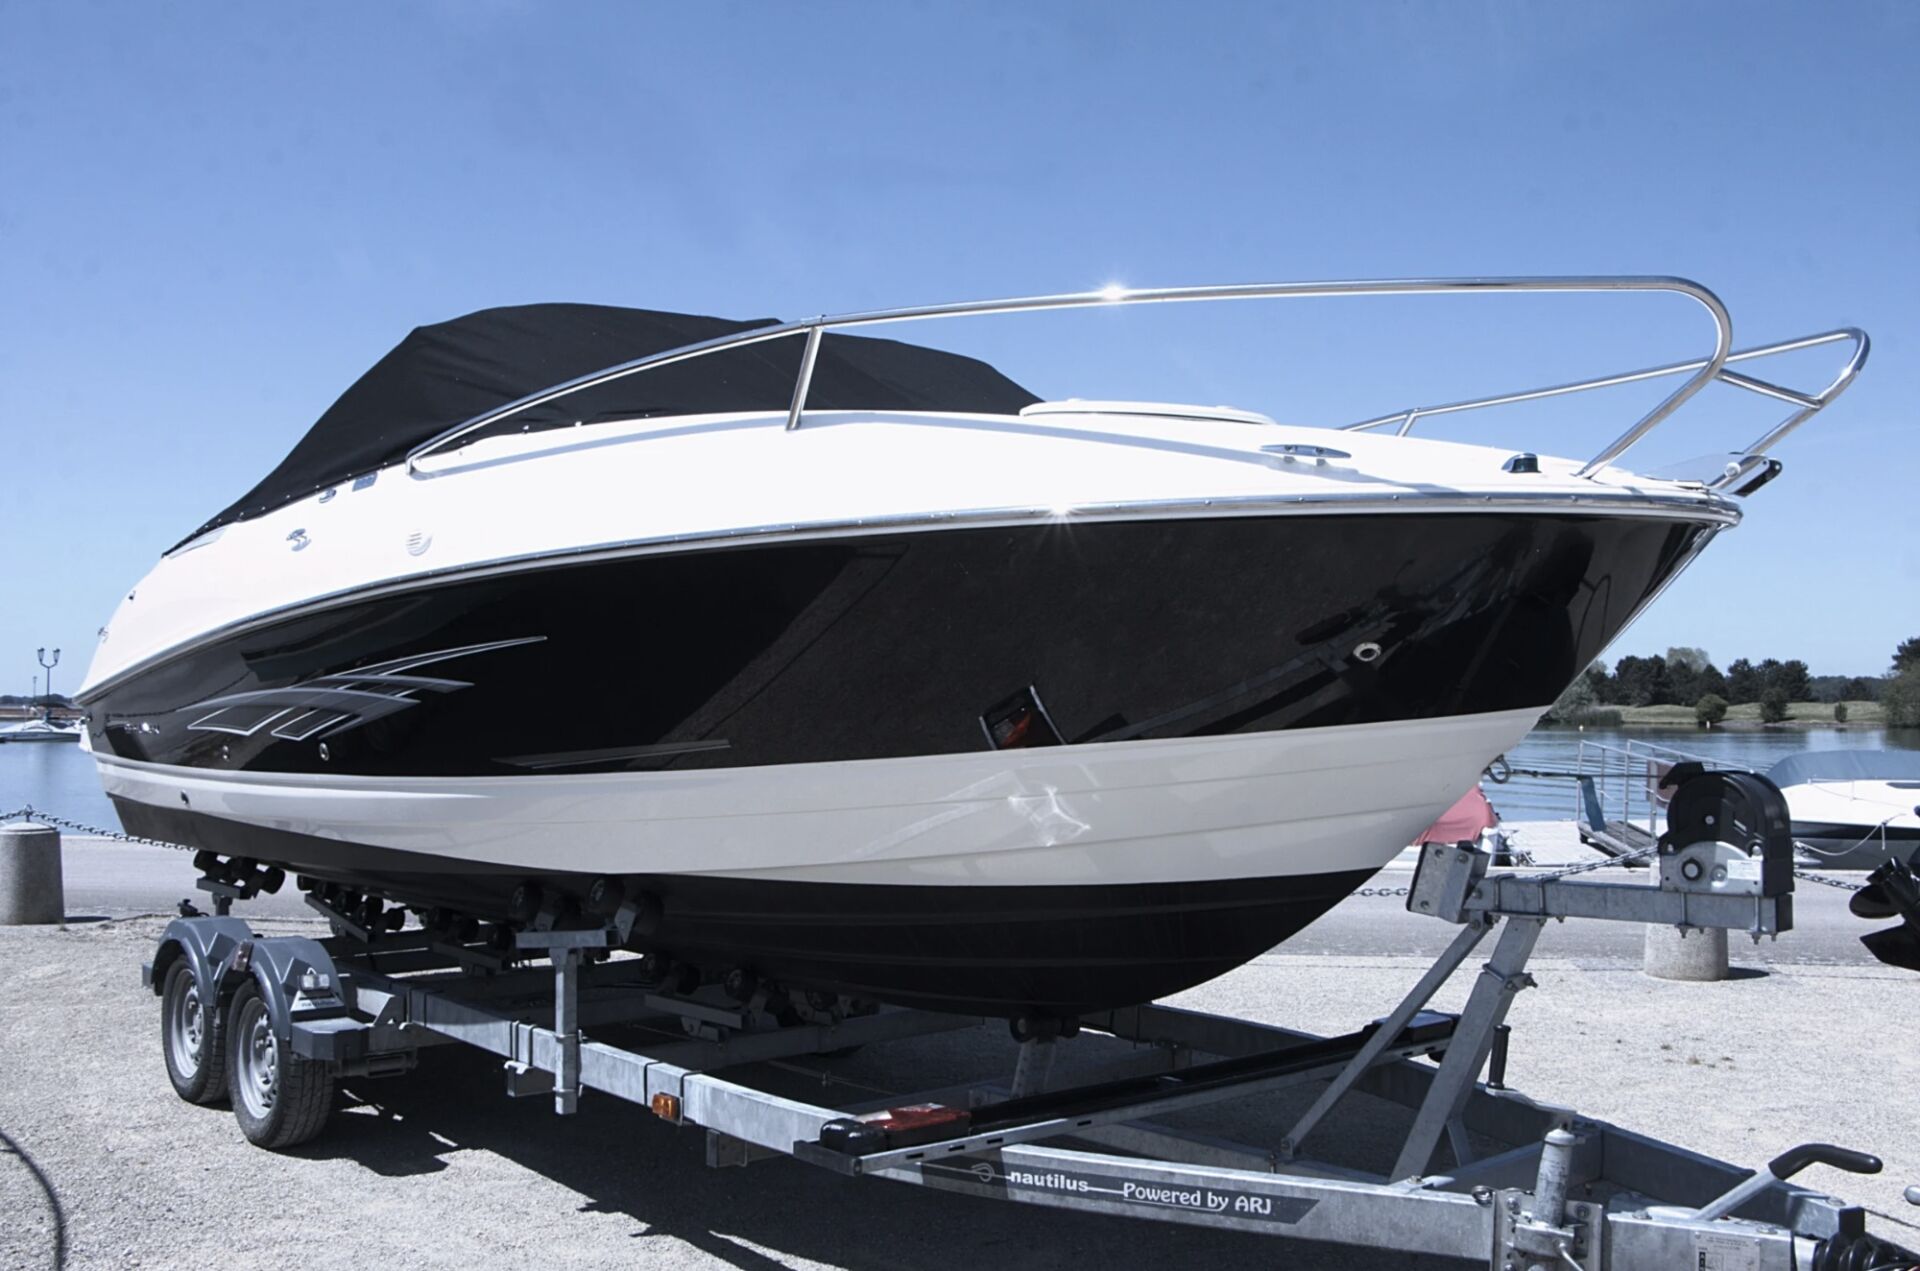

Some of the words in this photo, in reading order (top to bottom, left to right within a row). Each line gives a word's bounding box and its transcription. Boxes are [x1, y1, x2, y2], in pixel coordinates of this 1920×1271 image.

[1009, 1171, 1089, 1192] nautilus
[1123, 1182, 1201, 1206] Powered
[1207, 1192, 1229, 1212] by
[1234, 1196, 1272, 1214] ARJ
